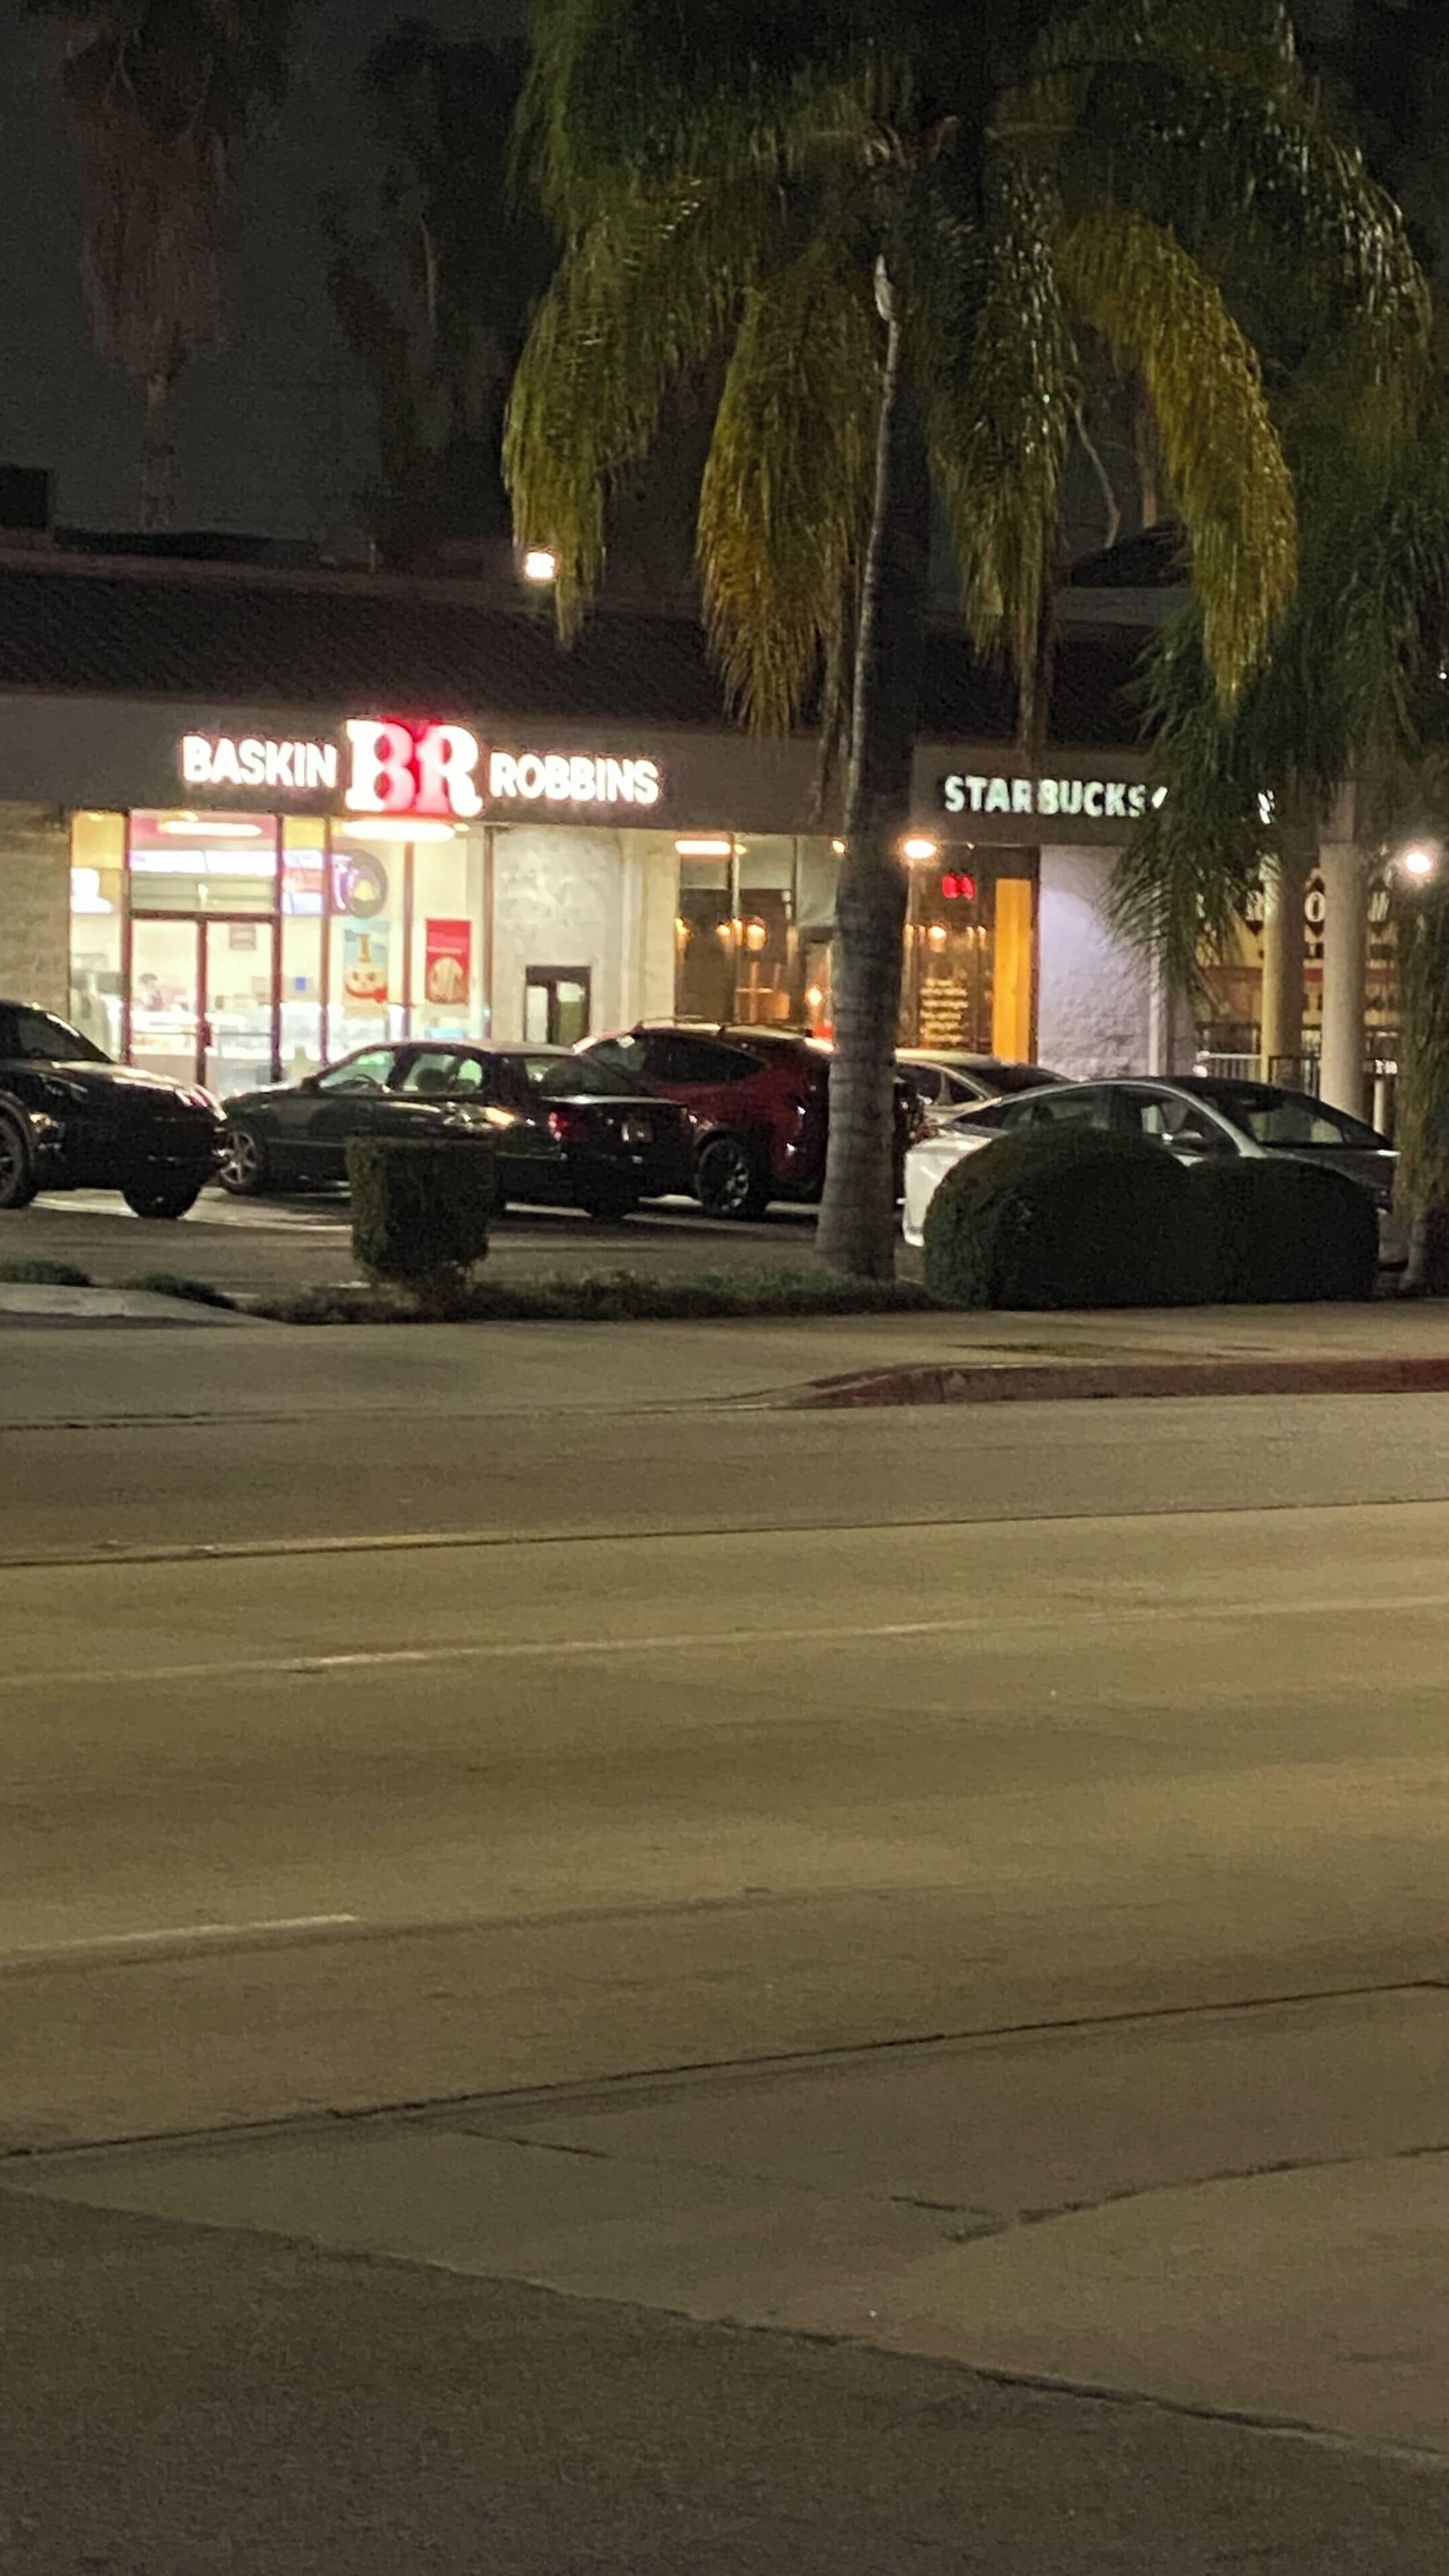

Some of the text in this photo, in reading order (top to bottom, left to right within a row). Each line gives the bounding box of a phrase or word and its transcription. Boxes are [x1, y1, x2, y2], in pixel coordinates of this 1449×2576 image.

[182, 718, 659, 818] BASKIN BR ROBBINS
[945, 775, 1146, 817] STARBUCKS
